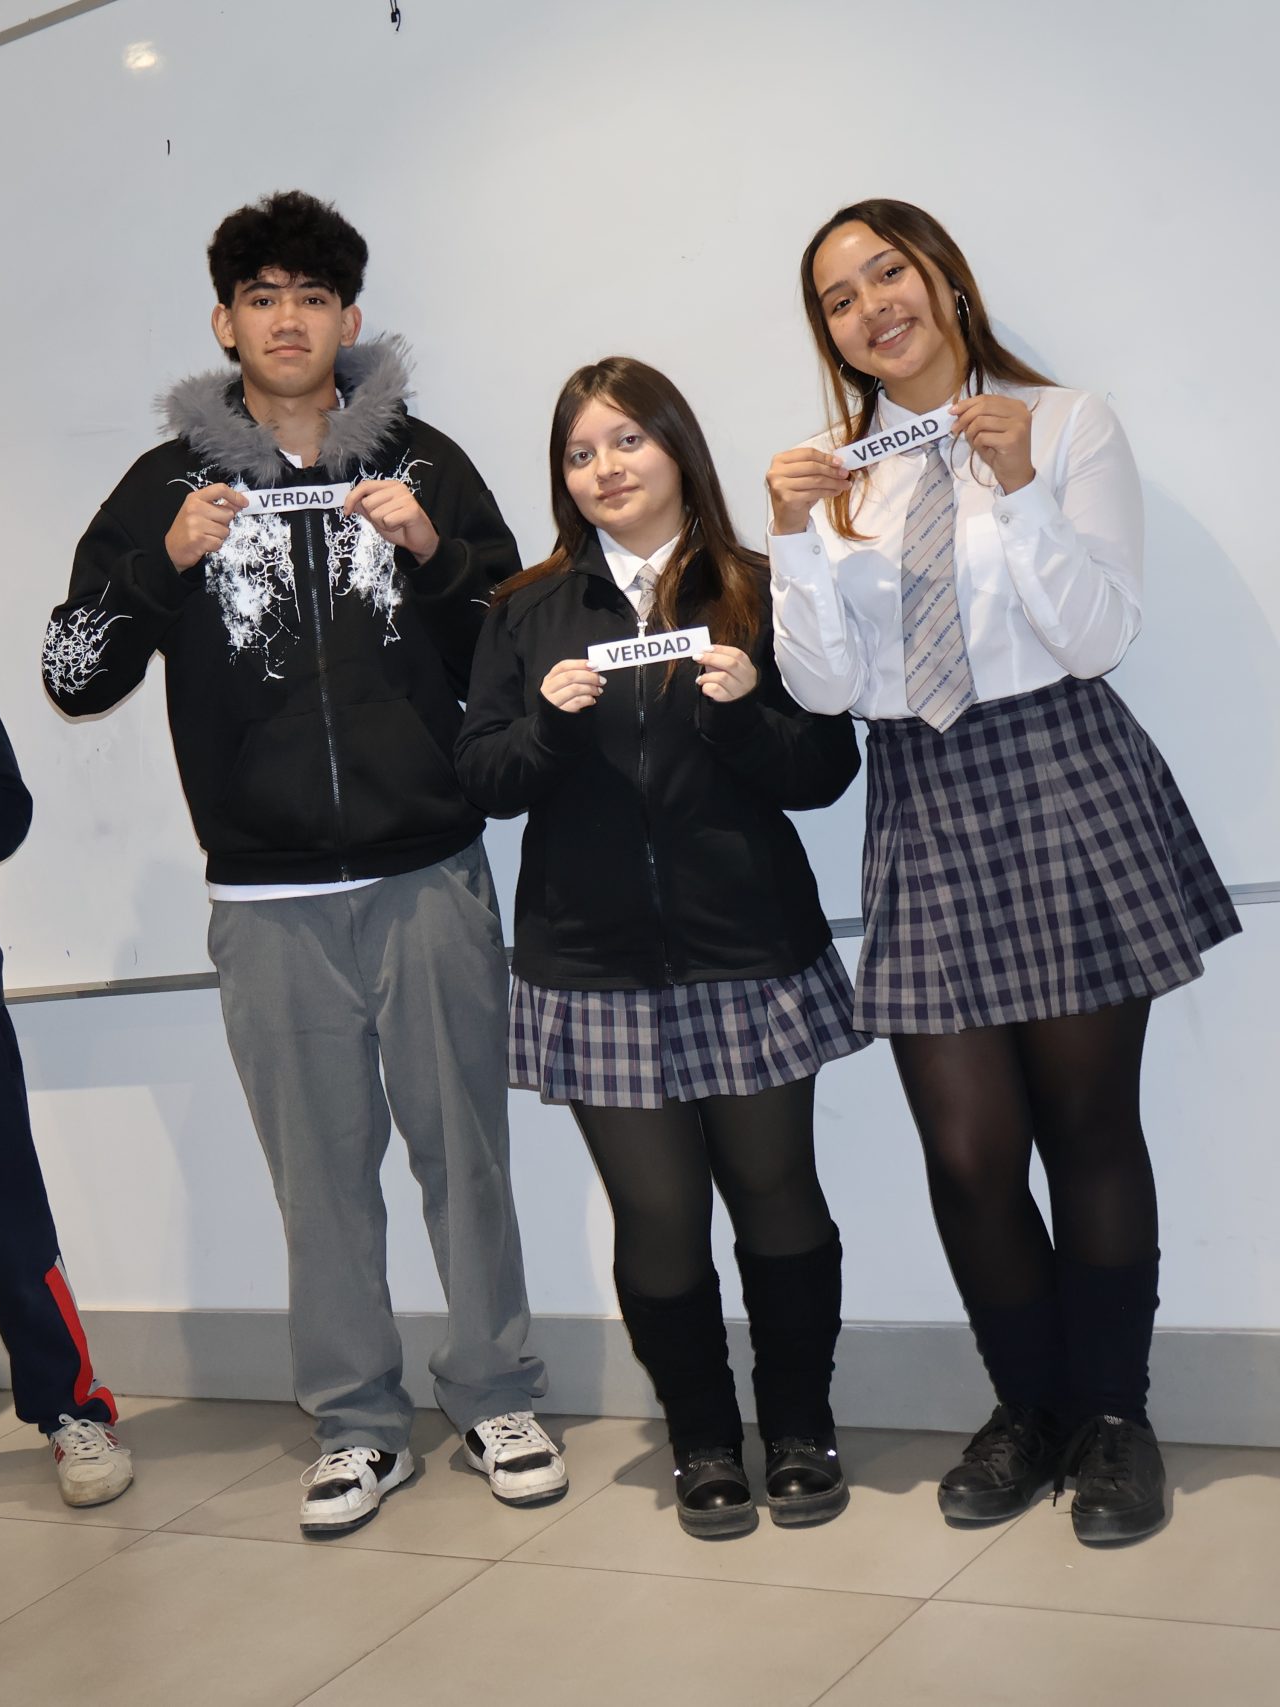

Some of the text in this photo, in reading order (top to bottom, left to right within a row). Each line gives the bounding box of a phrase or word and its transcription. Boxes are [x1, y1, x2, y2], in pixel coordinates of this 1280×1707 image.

[852, 419, 939, 462] VERDAD
[259, 490, 334, 508] VERDAD
[607, 636, 691, 663] VERDAD
